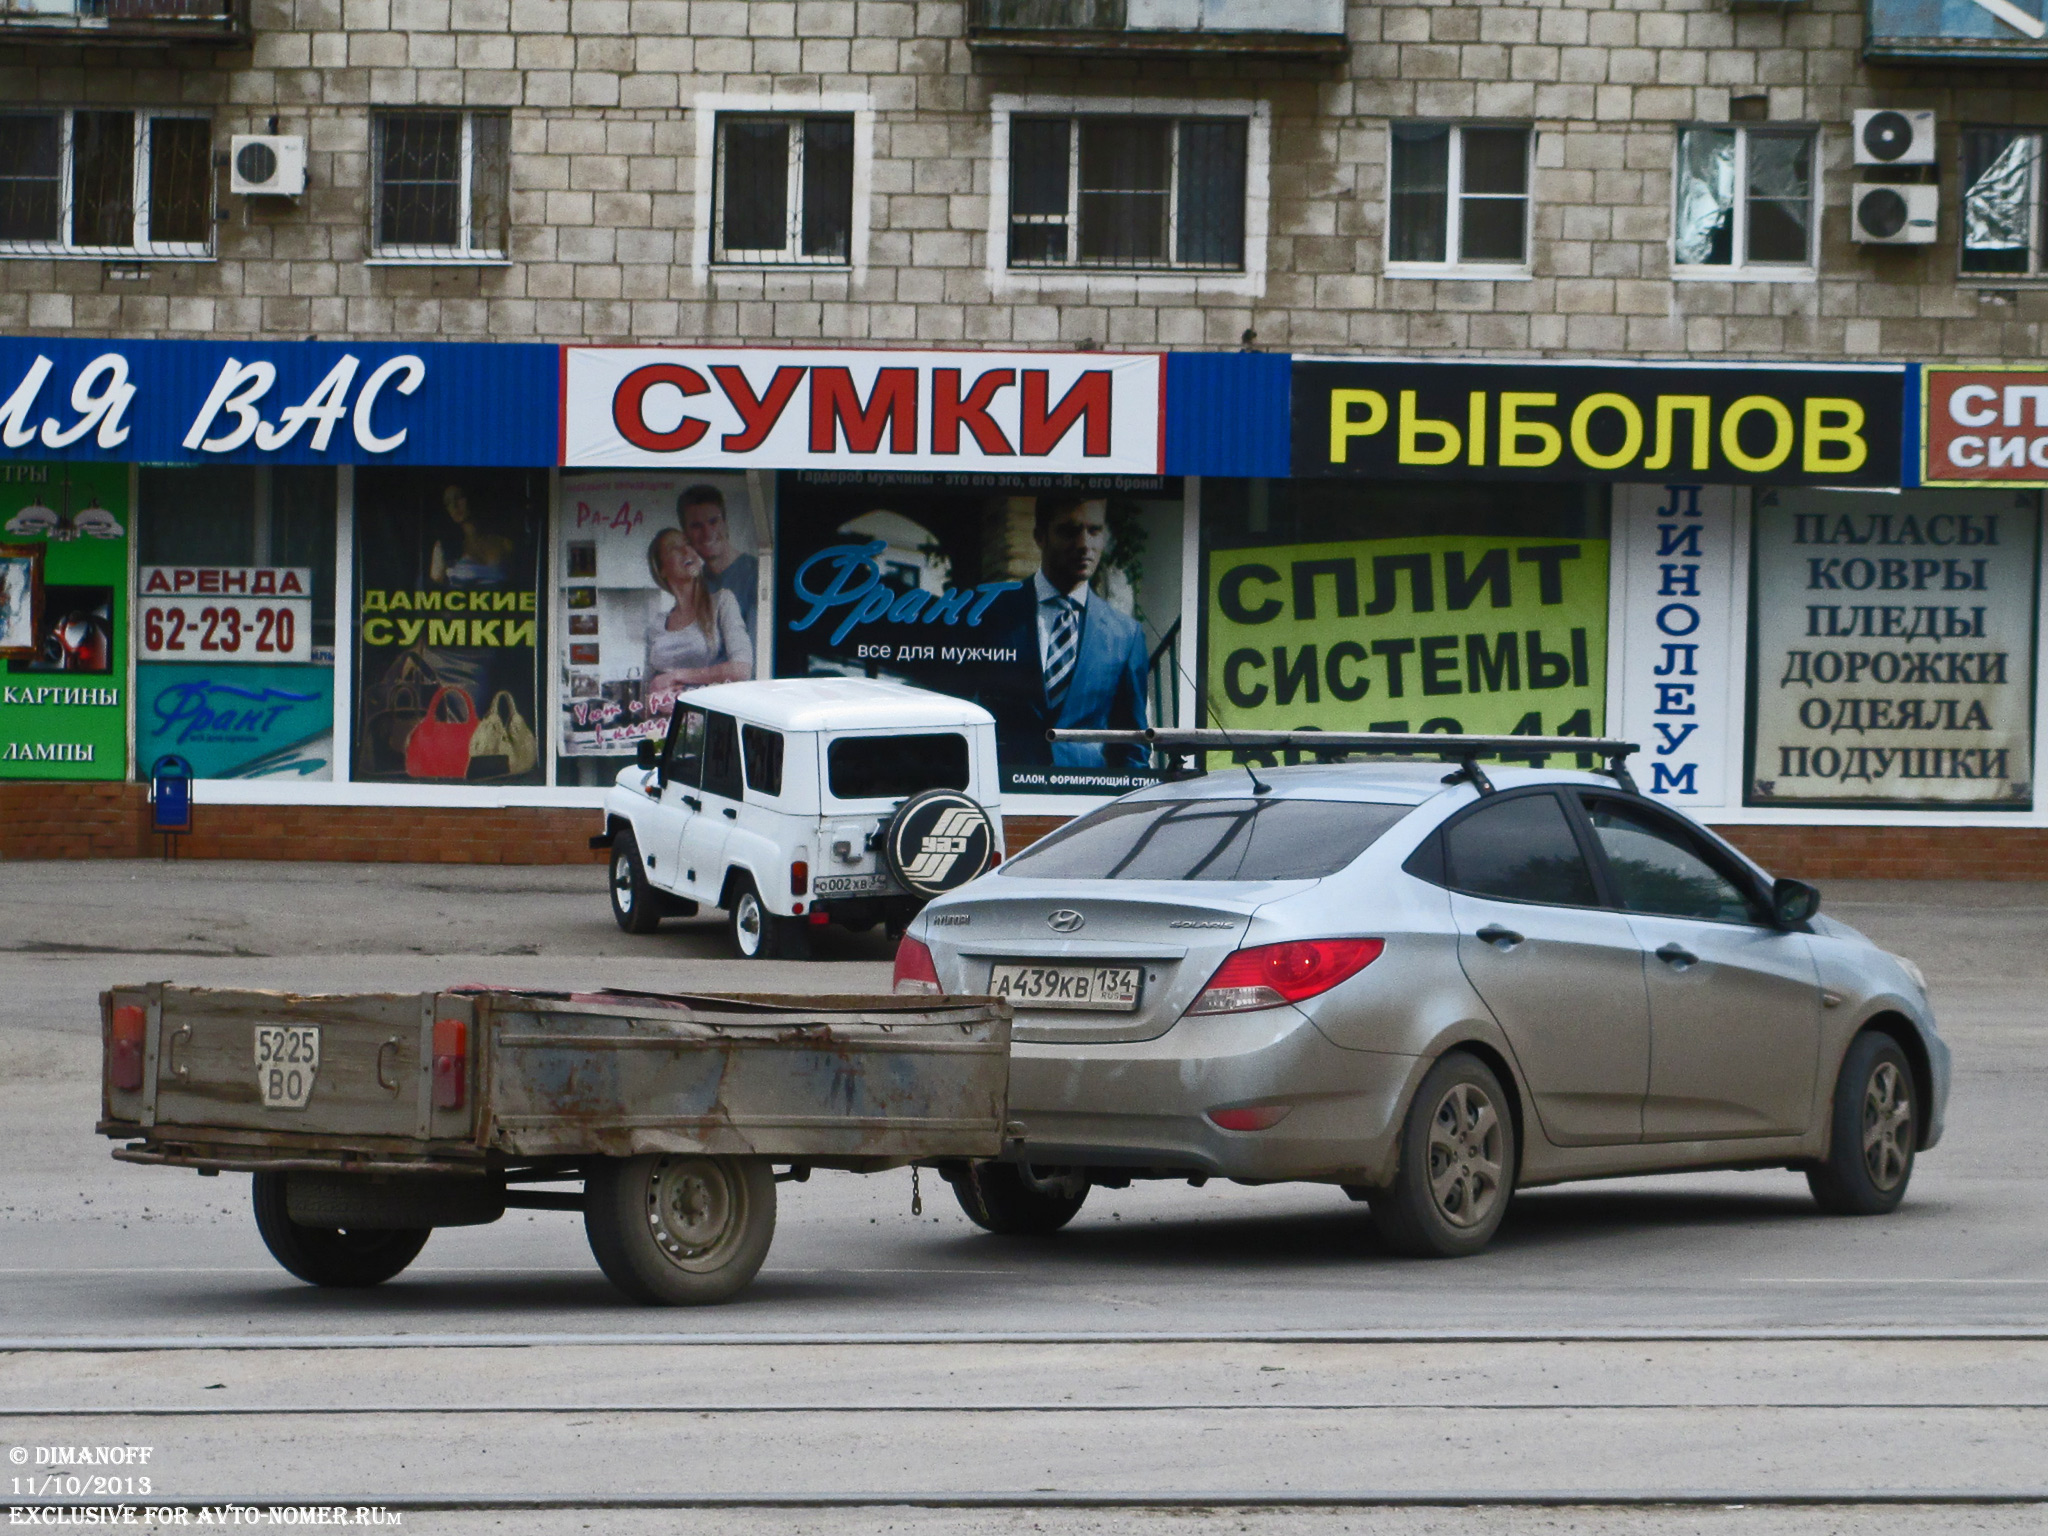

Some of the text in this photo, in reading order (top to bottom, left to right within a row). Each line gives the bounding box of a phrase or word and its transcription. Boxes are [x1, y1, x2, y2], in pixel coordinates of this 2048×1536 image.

[182, 354, 426, 453] ВАС
[611, 363, 1113, 457] СУМКИ
[1329, 388, 1868, 474] РЫБОЛОВ
[1793, 514, 2000, 545] ПАЛАСЫ
[146, 569, 302, 595] АРЕНДА
[1218, 544, 1581, 625] СПЛИТ
[1806, 558, 1989, 590] КОВРЫ
[363, 590, 537, 613] ДАМСКИЕ
[788, 540, 1023, 646] Франт
[145, 607, 294, 653] 62-23-20
[363, 617, 537, 647] СУМКИ
[1650, 484, 1704, 795] ЛИНОЛЕУМ
[1805, 605, 1987, 643] ПЛЕДЫ
[858, 644, 1017, 664] все для мужчин
[1223, 627, 1589, 709] СИСТЕМЫ
[1781, 651, 2009, 688] ДОРОЖКИ
[3, 686, 118, 706] КАРТИНЫ
[152, 680, 295, 745] Франт
[1799, 698, 1993, 735] ОДЕЯЛА
[2, 743, 94, 761] ЛАМПЫ
[1778, 746, 2010, 783] ПОДУШКИ
[1012, 773, 1048, 785] САЛОН,
[1050, 774, 1129, 787] ФОРМИРУЮЩИЙ
[1169, 919, 1235, 930] SOLARIS
[1097, 970, 1132, 989] 134
[260, 1031, 314, 1063] 5225
